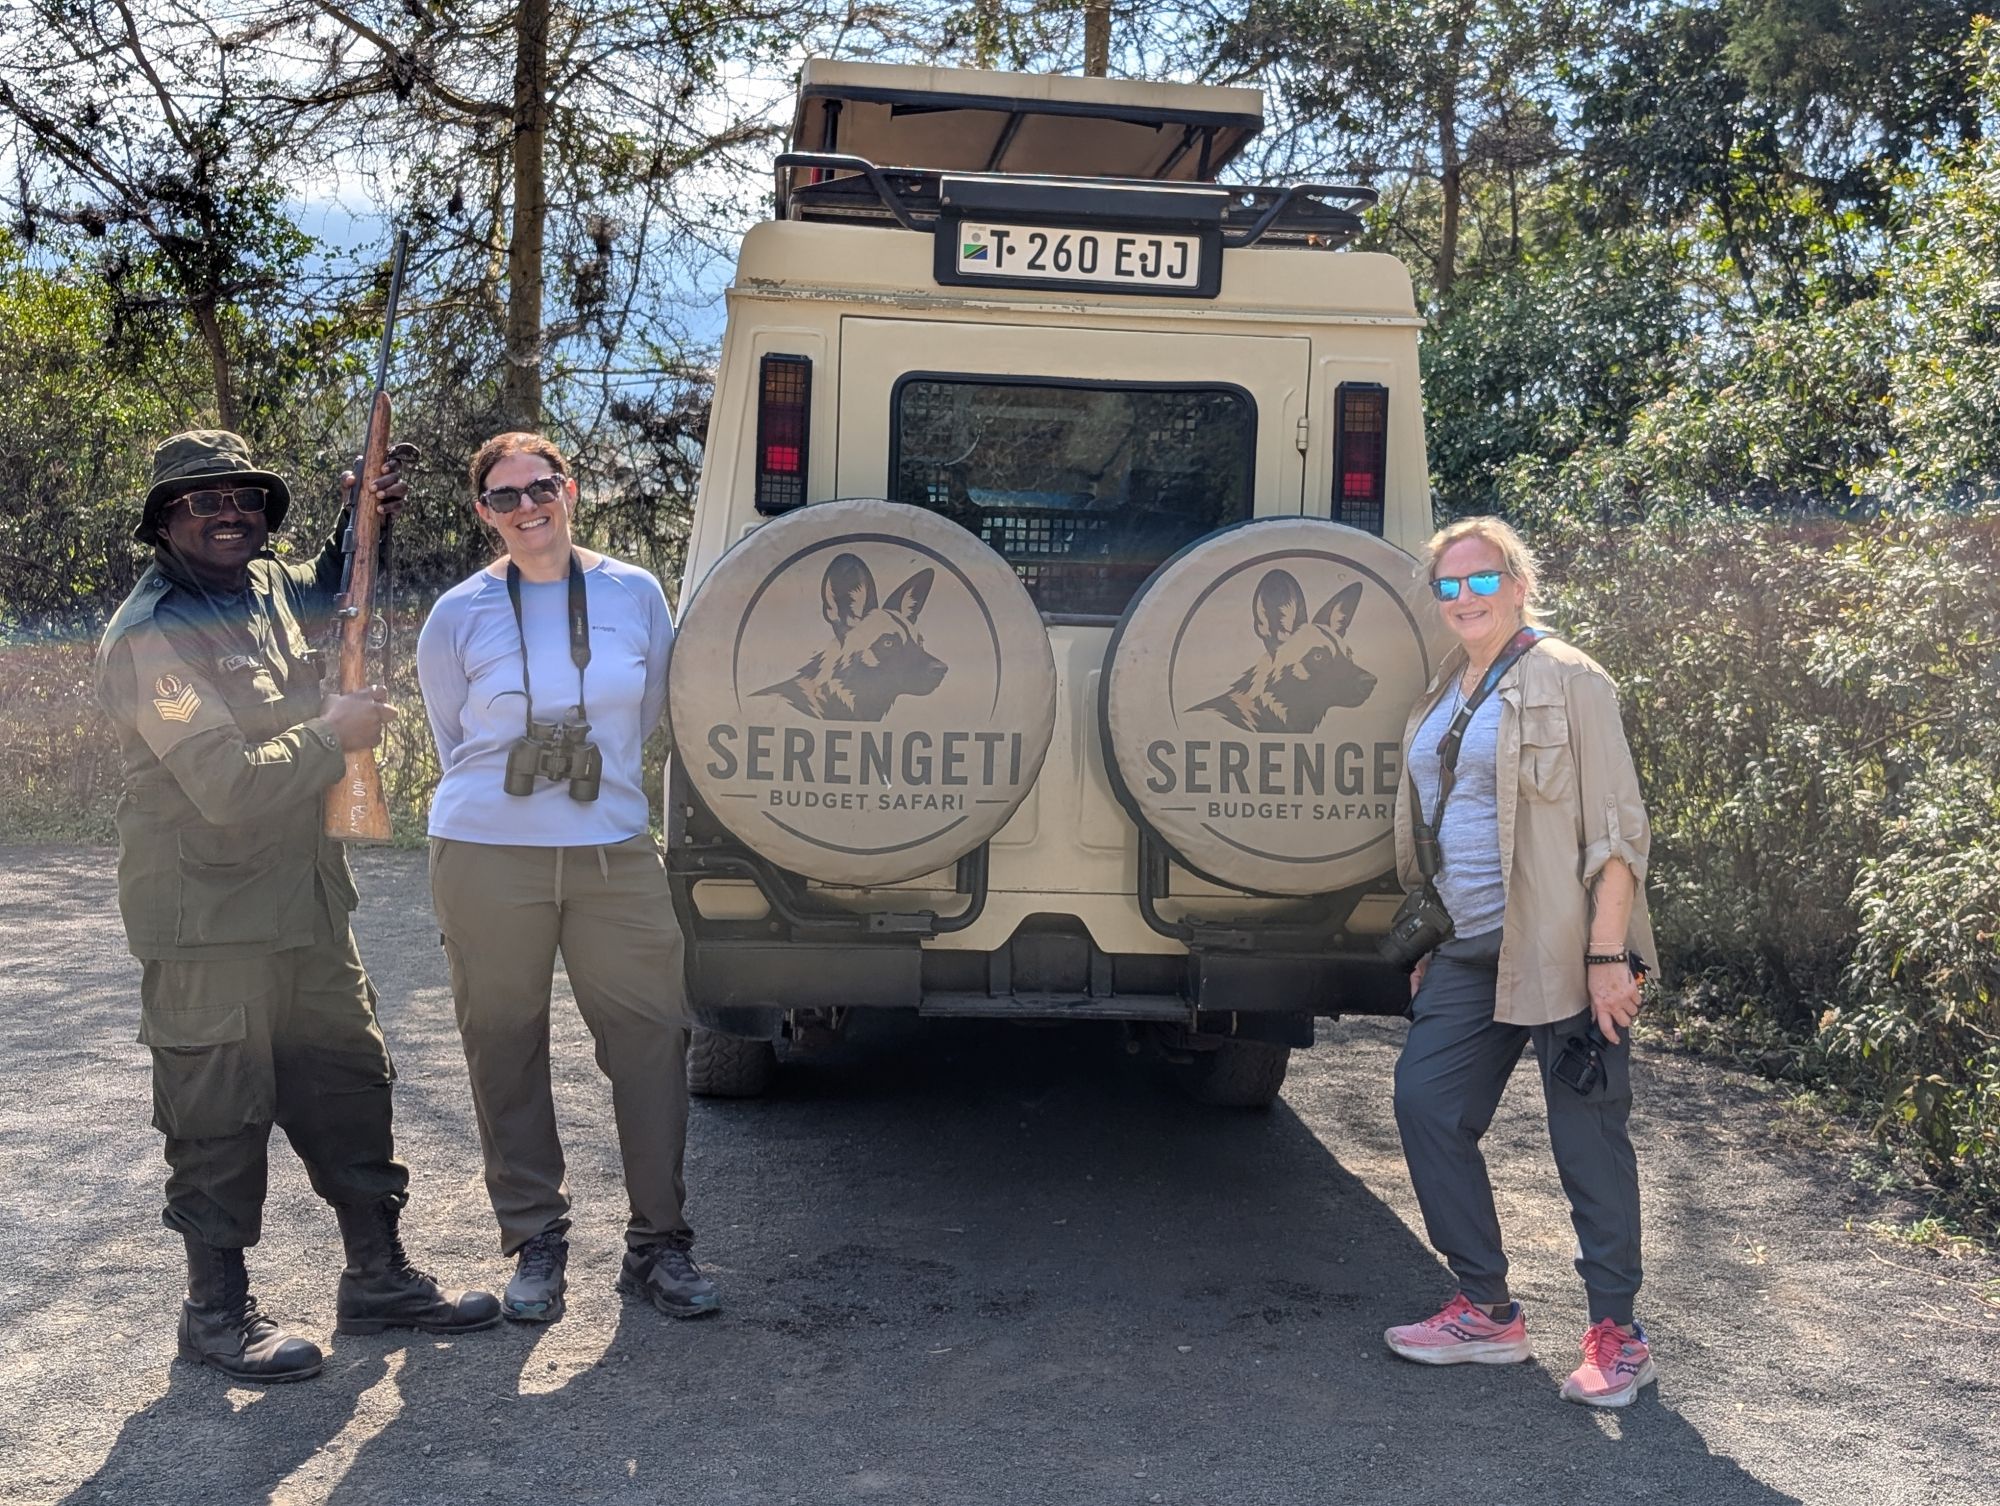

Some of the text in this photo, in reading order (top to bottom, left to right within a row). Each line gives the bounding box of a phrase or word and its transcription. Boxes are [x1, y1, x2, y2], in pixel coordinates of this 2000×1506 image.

[990, 229, 1188, 279] T 260 EJJ
[706, 723, 1022, 786] SERENGETI
[1147, 740, 1399, 796] SERENGE
[769, 789, 964, 811] BUDGET SAFARI
[1208, 802, 1303, 819] BUDGET
